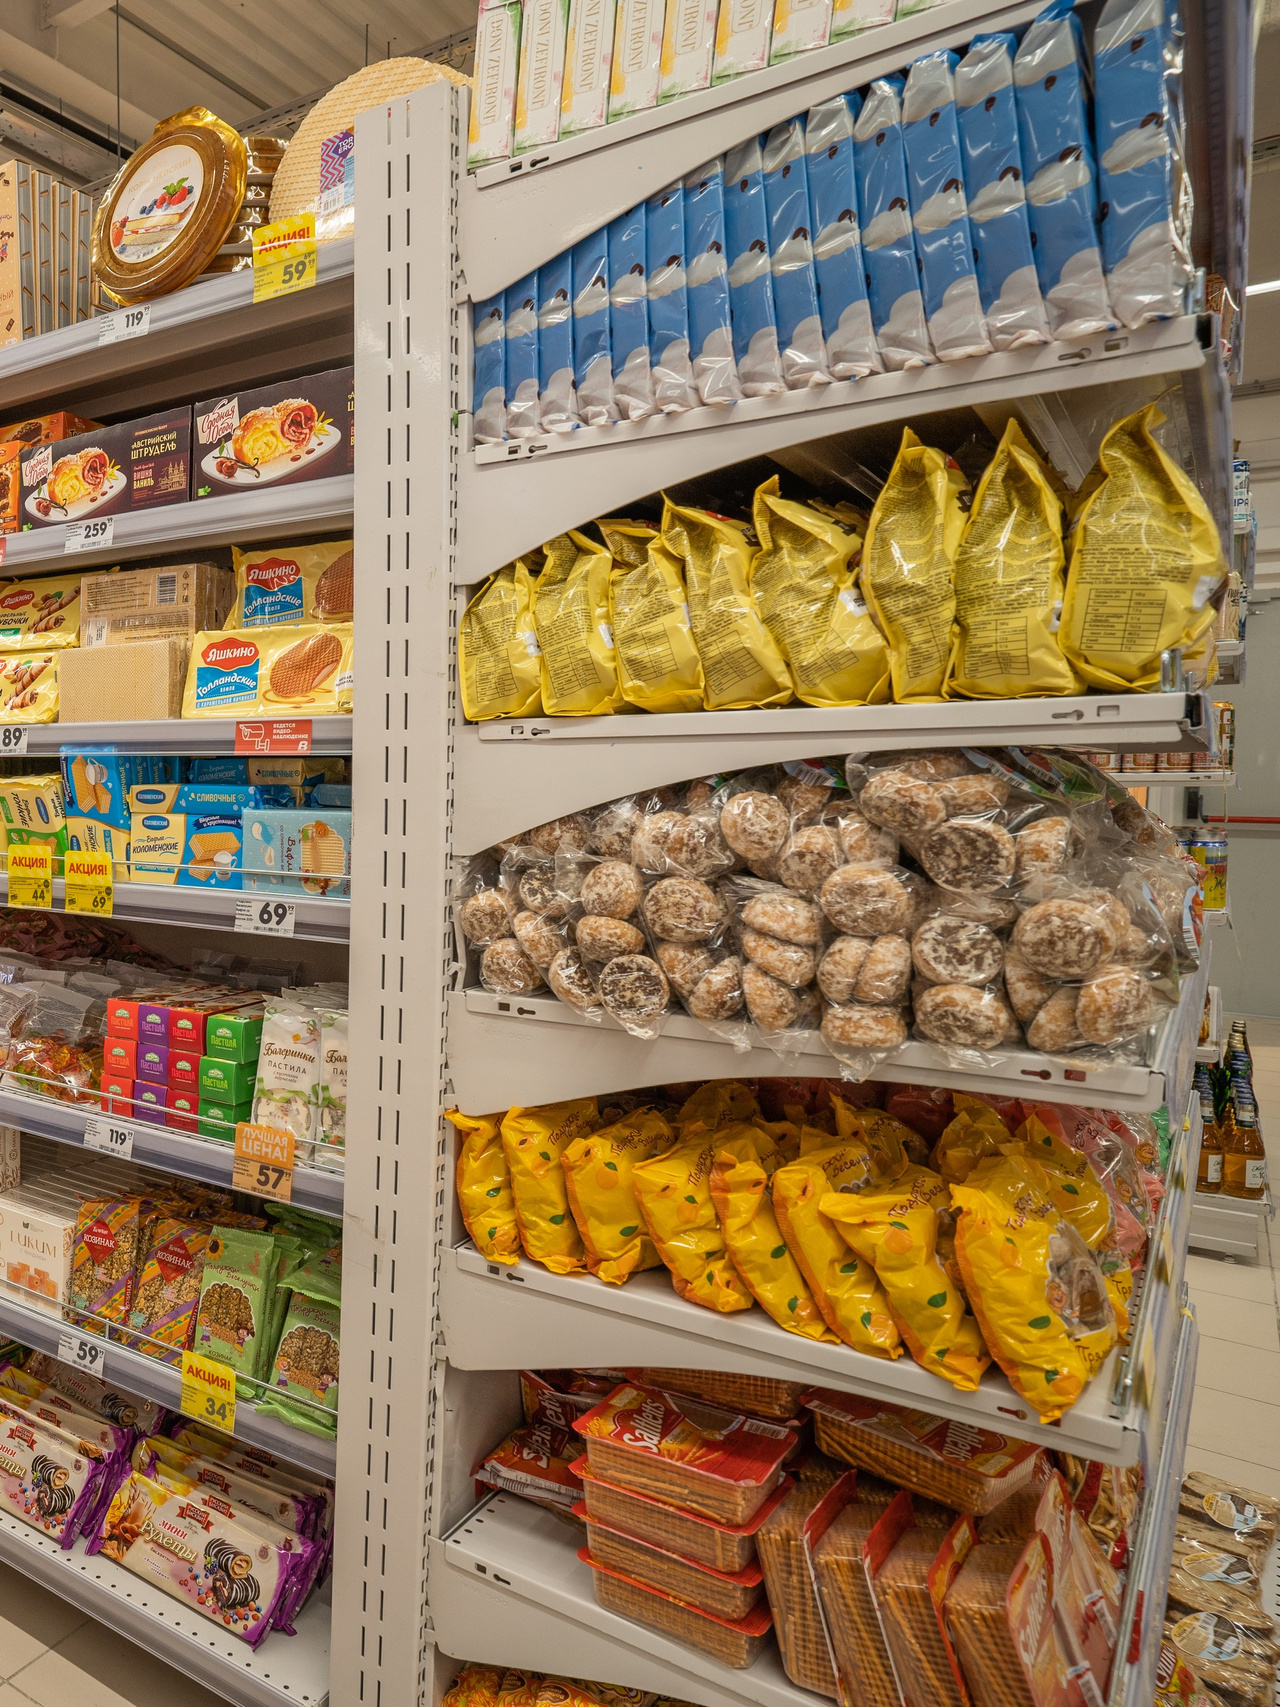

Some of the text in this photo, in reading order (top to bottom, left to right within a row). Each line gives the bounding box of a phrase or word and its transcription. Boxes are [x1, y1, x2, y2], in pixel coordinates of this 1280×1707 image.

[577, 18, 598, 93] ZEFIRONI
[483, 18, 503, 122] DONI ZEFIRONI
[531, 36, 549, 109] ZEFIRONI
[338, 136, 354, 148] TOR
[338, 142, 354, 155] ERO
[128, 155, 192, 194] КОРЖ НЕВСКИЙ
[258, 226, 310, 254] АКЦИЯ!
[281, 260, 307, 285] 59
[125, 310, 144, 328] 119
[131, 431, 177, 450] АВСТРИЙСКИЙ
[131, 441, 177, 460] ШТРУДЕЛЬ
[133, 477, 154, 490] ВАНИЛЬ
[84, 521, 108, 539] 259
[243, 591, 302, 617] Голландские
[206, 646, 255, 662] Яшкино
[196, 672, 257, 698] Голландские
[1, 728, 23, 748] 89
[197, 769, 236, 782] КОЛОМЕНСКИЕ
[261, 769, 294, 778] СЛИВОЧНЫЕ
[196, 793, 237, 803] СЛИВОЧНЫЕ
[11, 791, 30, 828] ТОНКИЕ
[132, 842, 179, 854] КОЛОМЕНСКИЕ
[286, 836, 296, 873] Вафли
[11, 856, 48, 869] АКЦИЯ!
[68, 862, 107, 876] АКЦИЯ!
[32, 889, 46, 901] 44
[92, 896, 106, 909] 69
[258, 902, 288, 926] 69
[262, 1042, 316, 1064] Балеринки
[267, 1061, 307, 1075] ПАСТИЛА
[109, 1128, 127, 1146] 119
[242, 1127, 288, 1147] ЛУЧШАЯ
[242, 1138, 288, 1162] ЦЕНА!
[256, 1164, 285, 1190] 57
[10, 1230, 57, 1259] LUKUM
[83, 1234, 115, 1249] КОЗИНАК
[156, 1251, 193, 1269] КОЗИНАК
[225, 1271, 260, 1293] Веселушки
[76, 1340, 99, 1365] 59
[208, 1350, 233, 1362] КОЗИНАК
[186, 1364, 231, 1391] АКЦИЯ!
[204, 1397, 235, 1422] 34 99
[623, 1396, 668, 1455] Saltletts
[159, 1519, 188, 1541] мини
[138, 1519, 199, 1564] Рулеты
